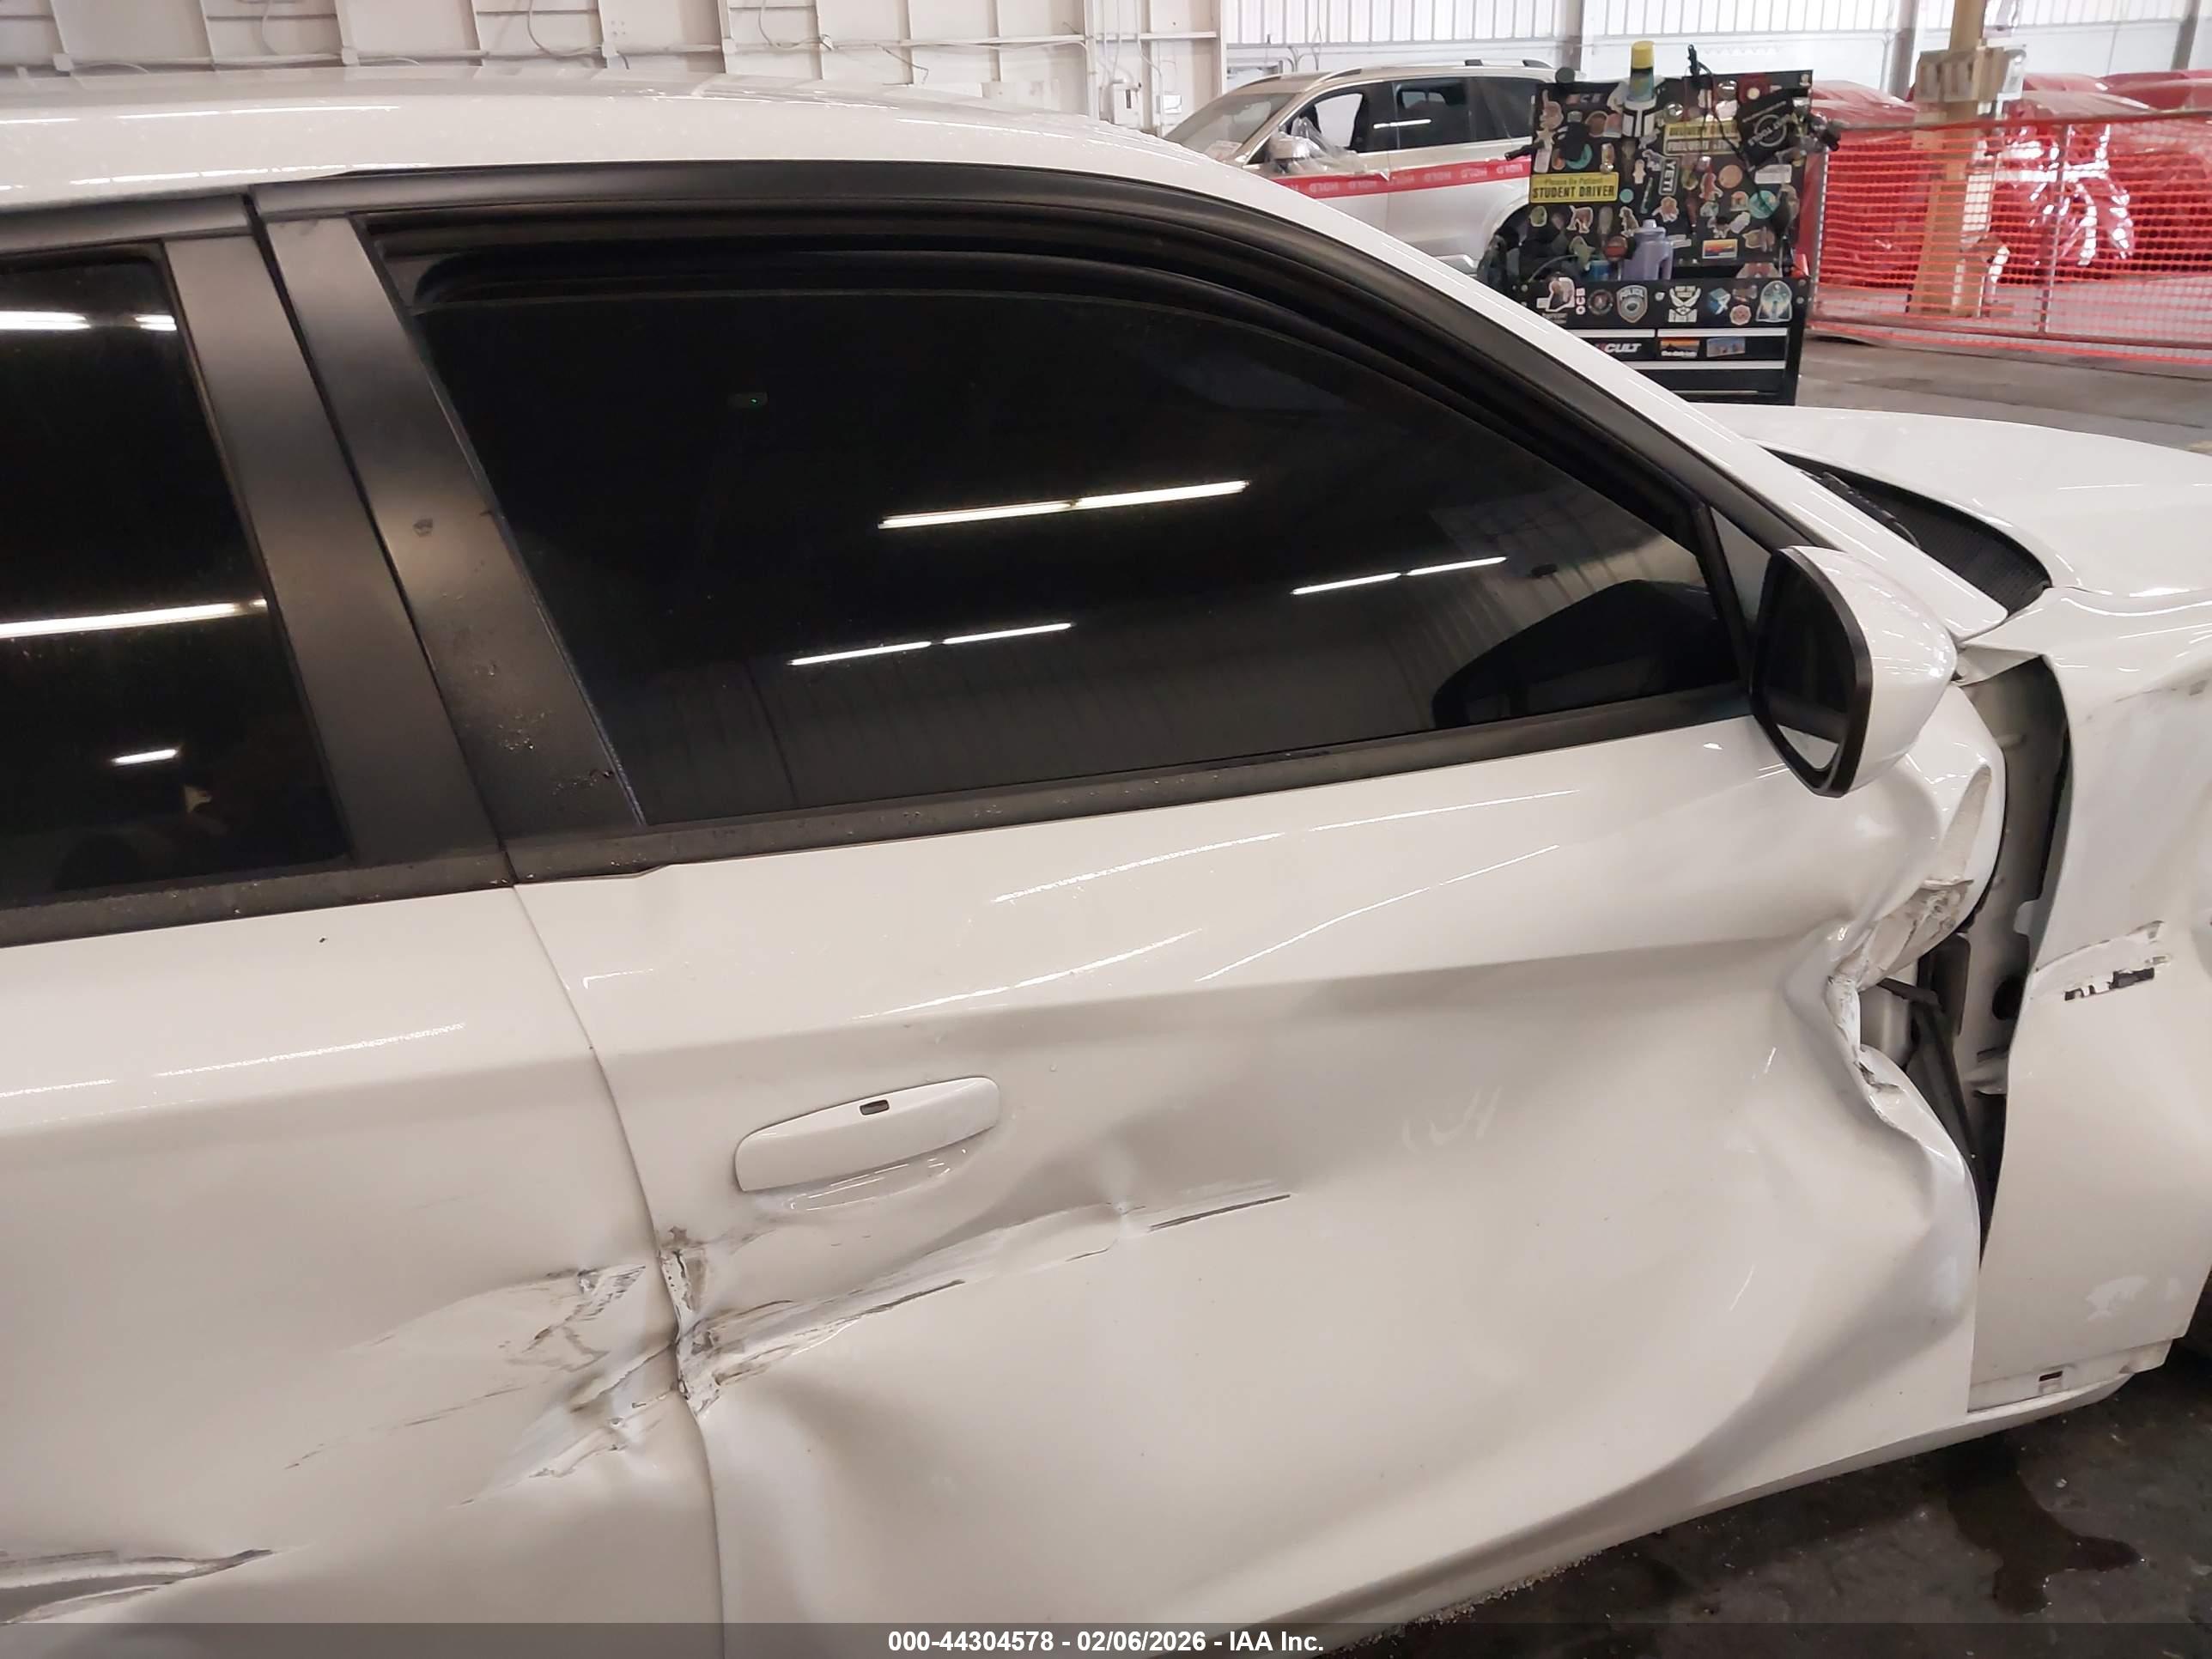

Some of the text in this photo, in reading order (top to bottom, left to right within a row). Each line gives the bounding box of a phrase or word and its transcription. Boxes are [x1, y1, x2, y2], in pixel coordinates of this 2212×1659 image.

[1662, 161, 1676, 191] YETI
[1533, 185, 1615, 198] STUDENT DRIVER
